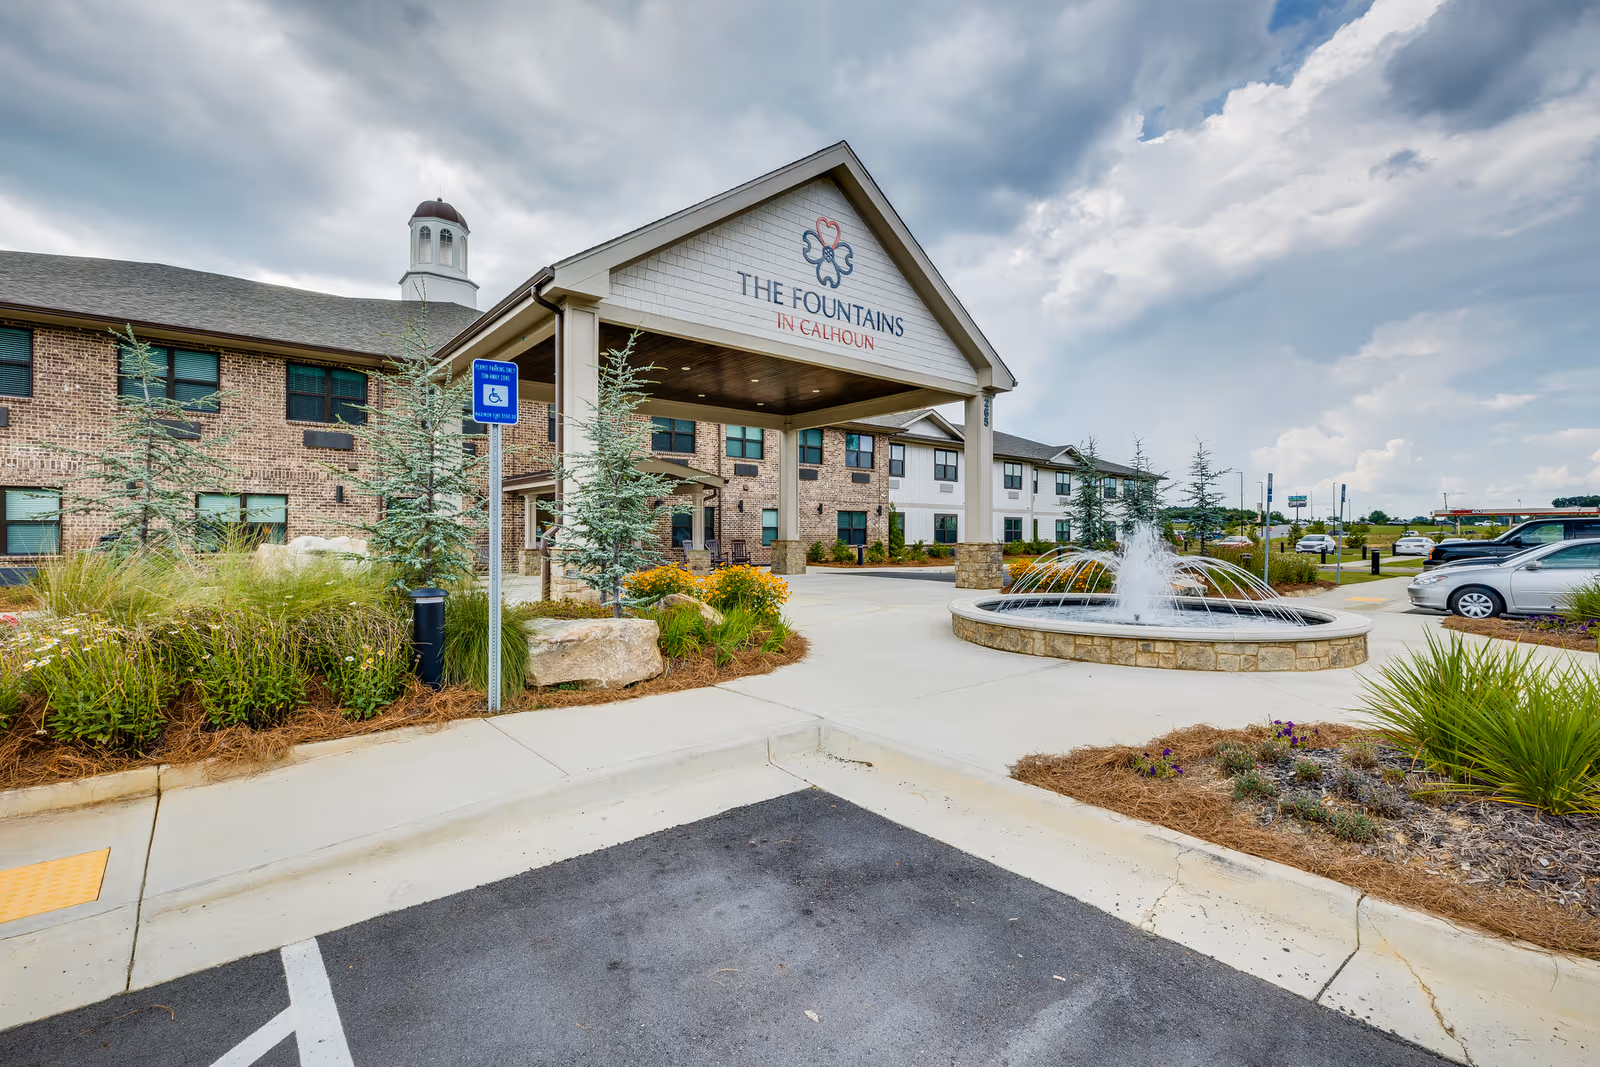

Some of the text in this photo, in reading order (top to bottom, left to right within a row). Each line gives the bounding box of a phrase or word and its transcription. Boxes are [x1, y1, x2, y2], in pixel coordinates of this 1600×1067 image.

[737, 271, 904, 337] THE FOUNTAINS
[777, 312, 874, 350] IN CALHOUN
[489, 365, 505, 373] PARKING
